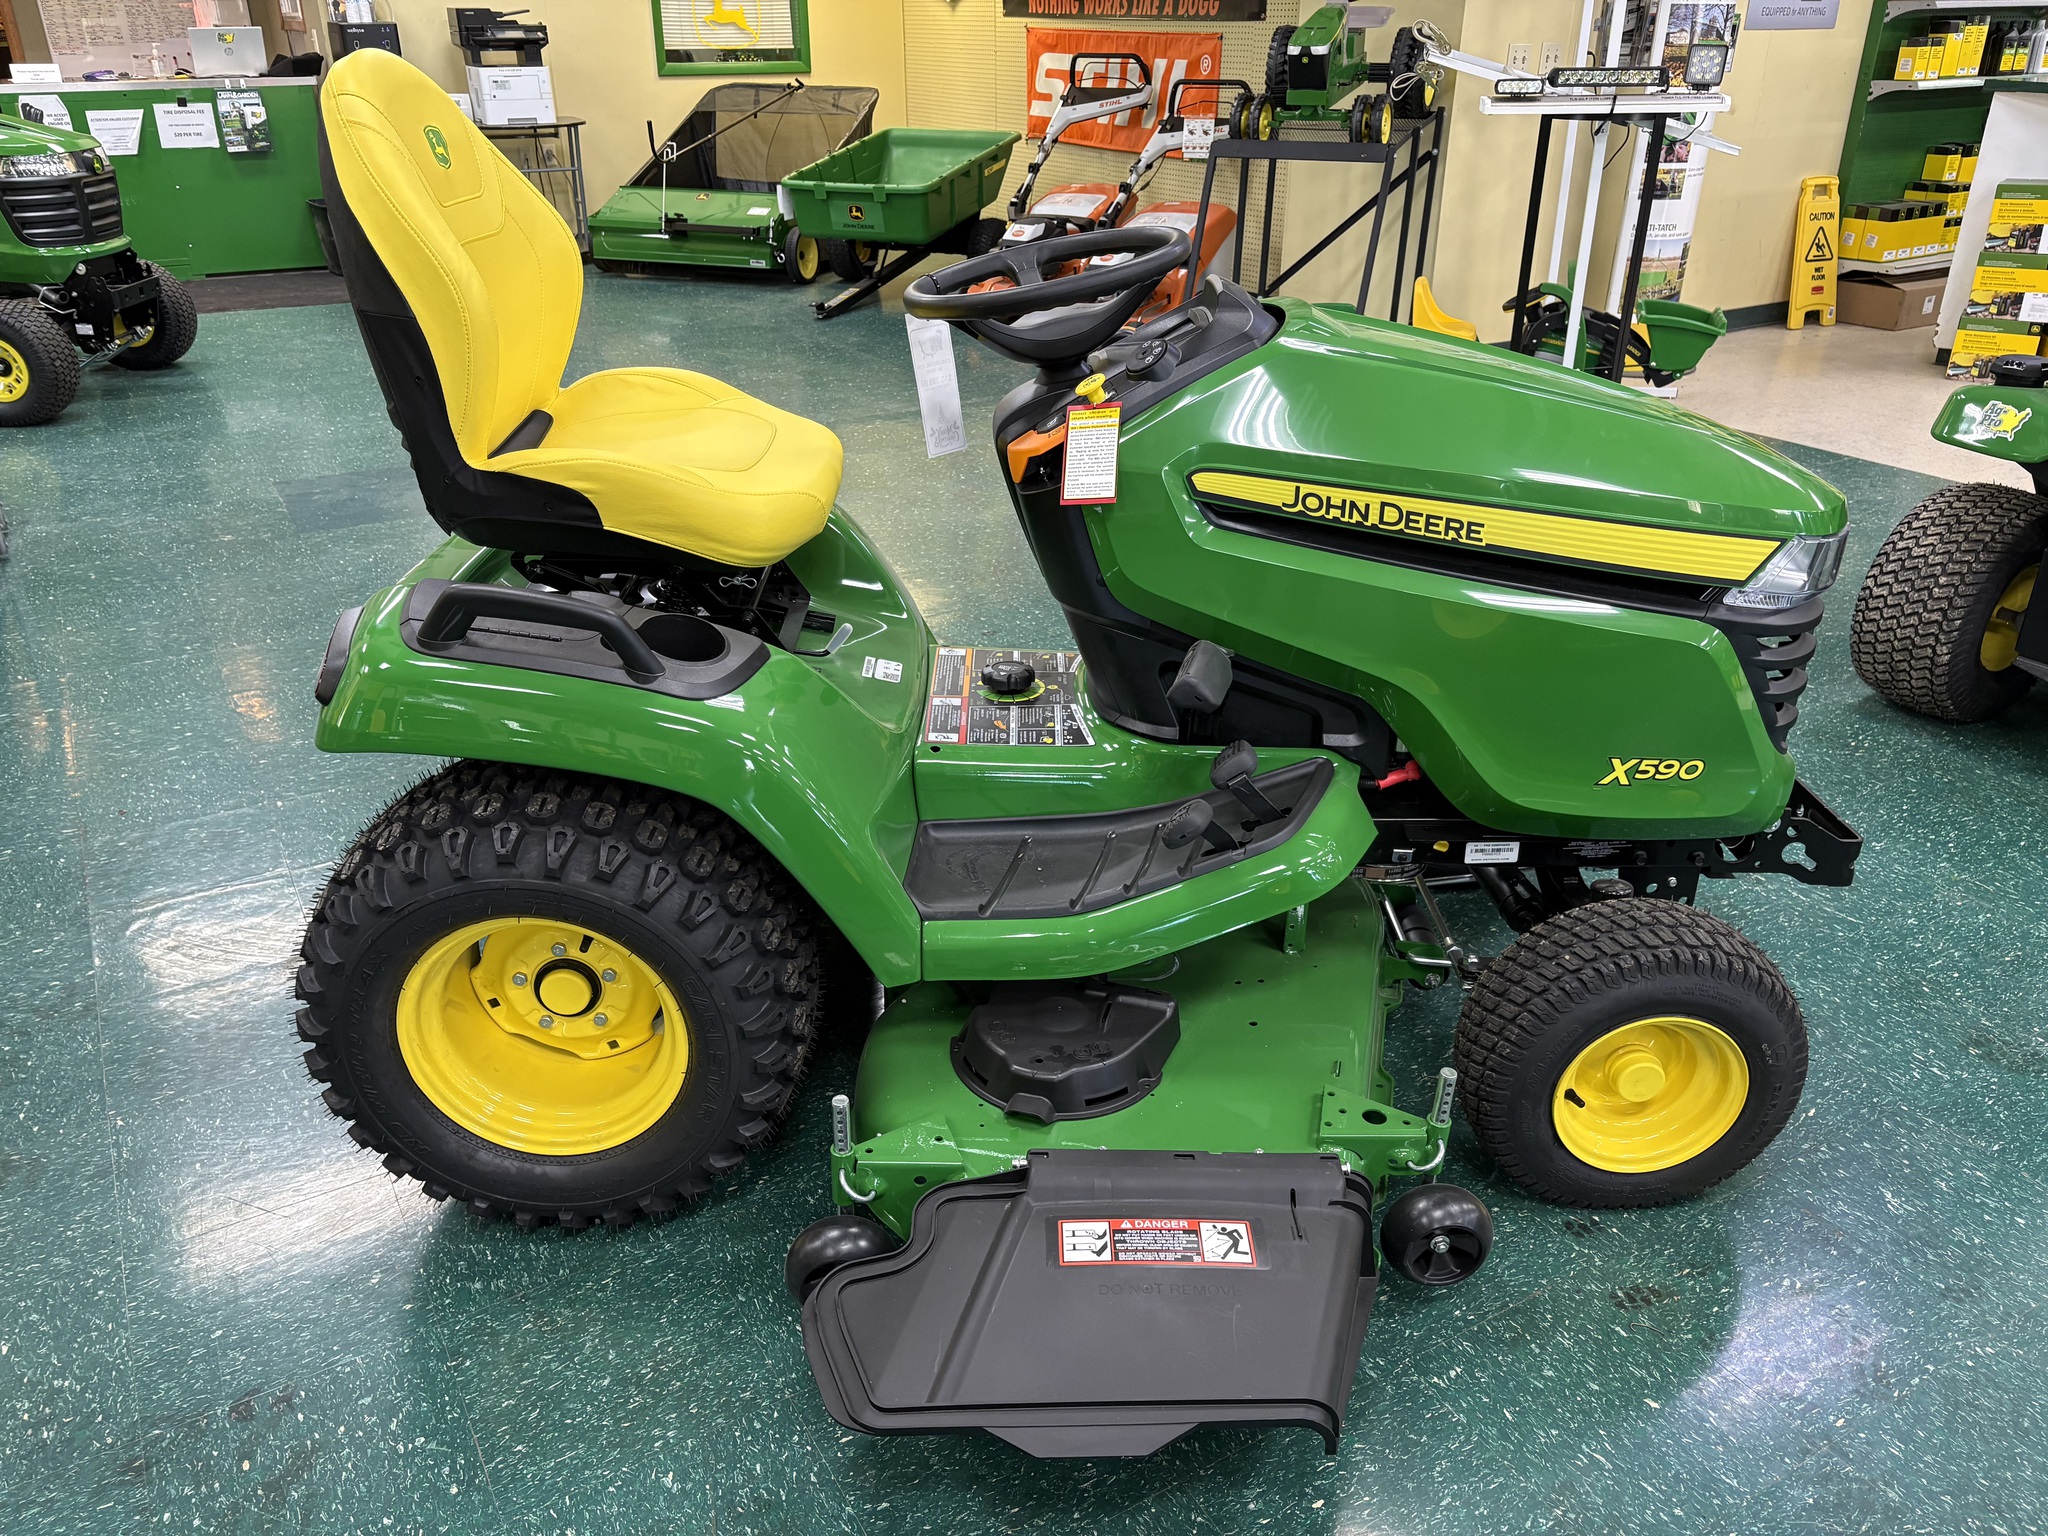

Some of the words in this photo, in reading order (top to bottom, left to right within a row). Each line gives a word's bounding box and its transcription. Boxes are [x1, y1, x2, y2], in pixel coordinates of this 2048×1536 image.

[1029, 0, 1078, 14] NOTHING
[1084, 0, 1127, 15] WORKS
[1132, 0, 1159, 15] LIKE
[1163, 0, 1177, 16] A
[1179, 0, 1220, 16] DOGG
[1762, 6, 1791, 16] EQUIPPED
[1797, 6, 1826, 16] ANYTHING
[1098, 99, 1122, 108] STIHL
[1809, 212, 1835, 221] CAUTION
[1632, 224, 1677, 232] MTI-TATCH
[1985, 404, 2008, 417] Ag-
[1979, 414, 2002, 426] Pro
[1281, 484, 1372, 524] JOHN
[1378, 502, 1485, 544] DEERE
[1593, 757, 1705, 786] X590
[1099, 1284, 1122, 1295] DO
[1129, 1284, 1163, 1295] NOT
[1170, 1284, 1243, 1296] REMOVE
